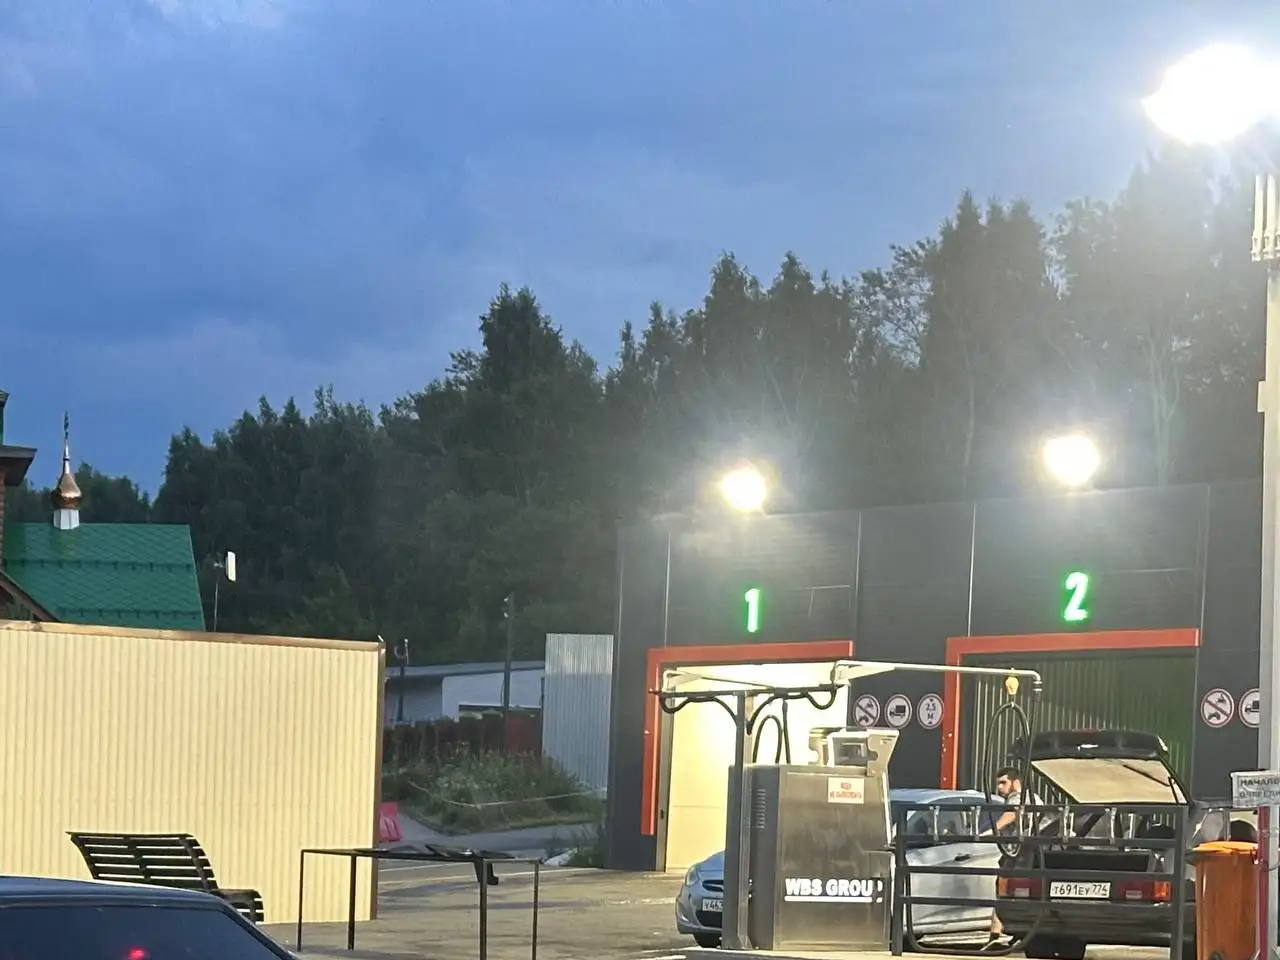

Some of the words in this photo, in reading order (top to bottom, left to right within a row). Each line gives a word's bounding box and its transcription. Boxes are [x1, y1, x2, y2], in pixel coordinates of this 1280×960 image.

[744, 587, 761, 633] 1
[1064, 571, 1090, 622] 2
[785, 878, 822, 896] WBS
